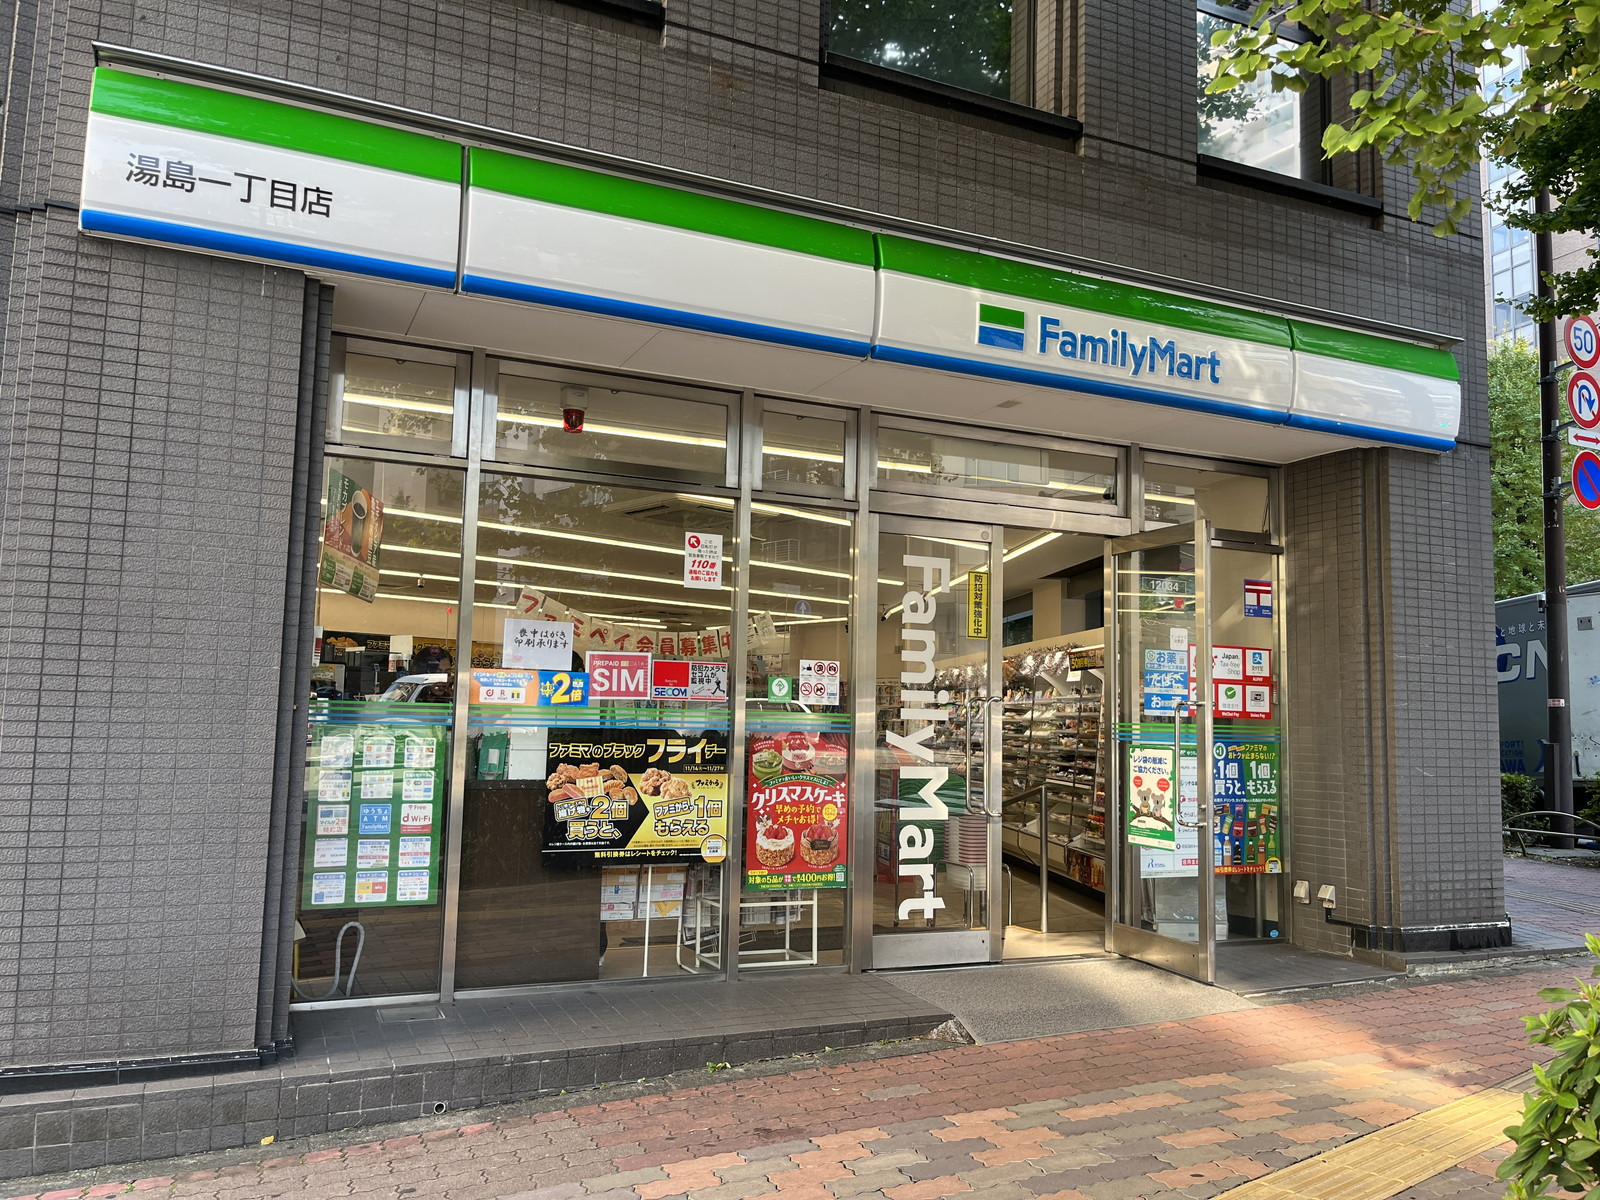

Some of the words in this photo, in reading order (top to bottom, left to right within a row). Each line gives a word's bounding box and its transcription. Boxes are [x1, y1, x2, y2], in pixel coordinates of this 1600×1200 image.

[125, 152, 333, 218] 湯島一丁目店
[1573, 326, 1593, 354] 50
[1038, 315, 1221, 384] FamilyMart
[691, 559, 717, 569] 110番
[1150, 580, 1179, 592] 12034
[973, 574, 984, 636] 防犯対策強化中
[519, 628, 566, 641] 喪中はがき
[1496, 620, 1546, 638] と地球と未
[514, 638, 568, 649] 印刷承ります
[1156, 652, 1176, 664] お薬
[691, 664, 726, 673] 防犯カメラで
[1227, 668, 1240, 676] Shop
[592, 668, 645, 692] SIM
[654, 687, 687, 697] SECOM
[885, 554, 951, 920] FamilyMart
[1133, 755, 1168, 765] レジ袋の削減に
[1133, 765, 1170, 776] ご協力ください。
[1217, 760, 1239, 779] 1個
[1249, 760, 1271, 779] 1個
[695, 779, 720, 787] ファミから
[1215, 780, 1245, 795] 買うと、
[1247, 780, 1277, 795] もらえる
[751, 785, 846, 811] クリスマスケーキ
[775, 804, 822, 815] 早めの予約で
[777, 815, 820, 825] メチャお得!
[567, 820, 622, 840] 買うと、
[654, 819, 710, 836] もらえる
